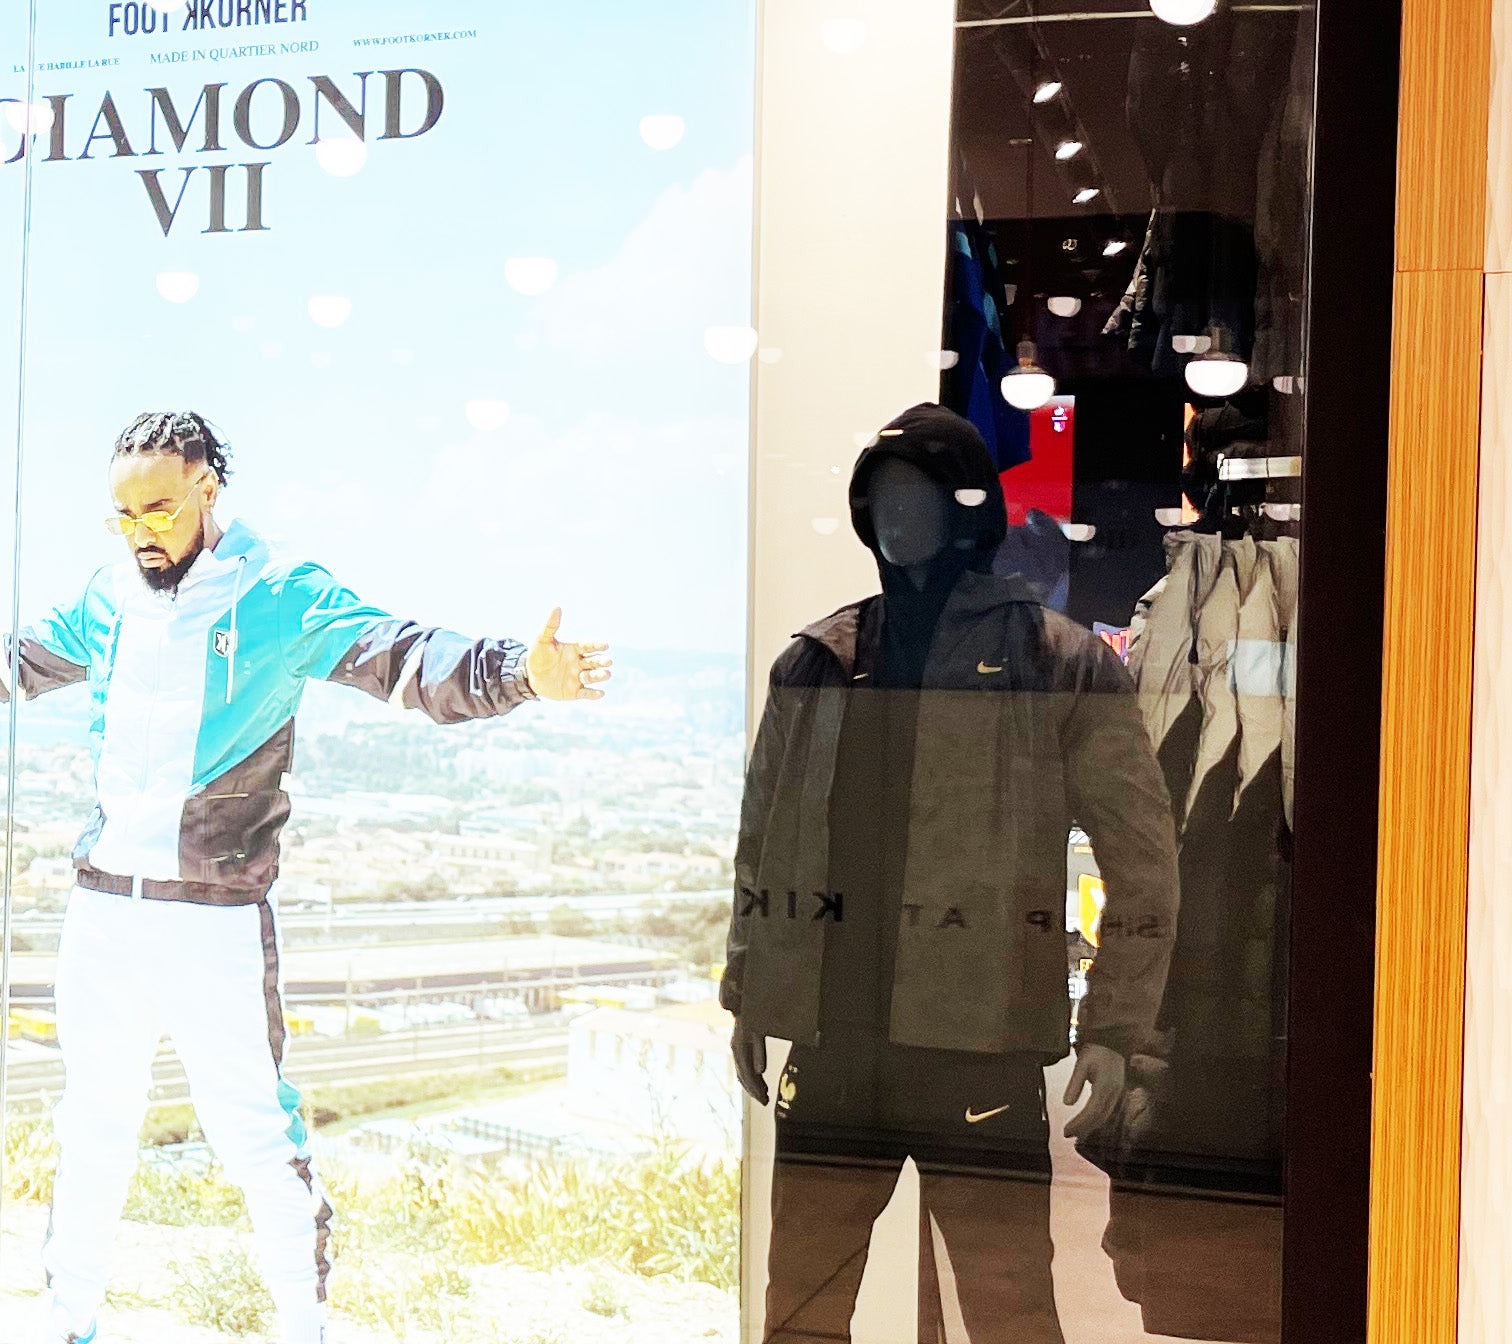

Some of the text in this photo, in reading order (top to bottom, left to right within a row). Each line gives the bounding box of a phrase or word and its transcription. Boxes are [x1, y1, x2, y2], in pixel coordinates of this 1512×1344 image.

[150, 40, 319, 65] MADE IN QUARTIER NORD
[133, 162, 272, 238] VII
